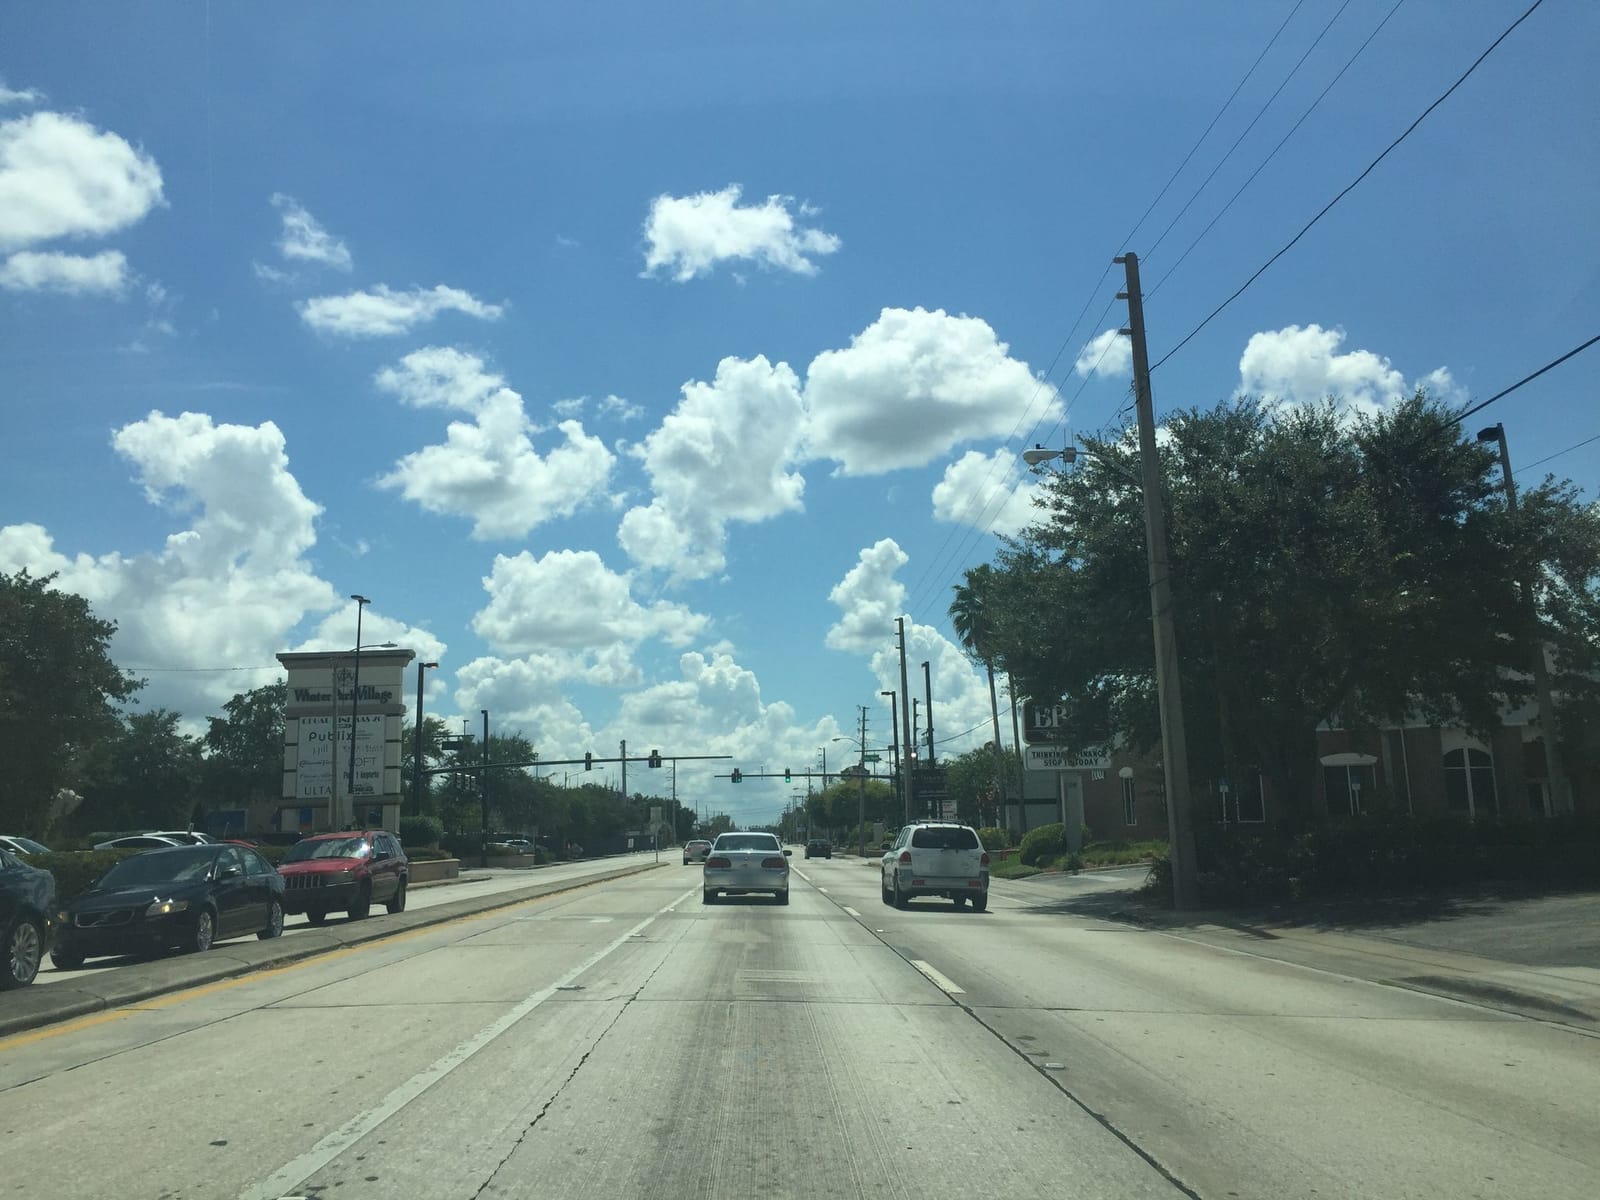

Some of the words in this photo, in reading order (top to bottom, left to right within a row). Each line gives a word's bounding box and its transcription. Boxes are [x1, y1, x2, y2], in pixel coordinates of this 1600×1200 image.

[294, 688, 332, 702] Winter
[357, 685, 393, 704] Village
[308, 730, 354, 742] Publix
[354, 757, 376, 767] OFT
[304, 786, 332, 796] ULTA
